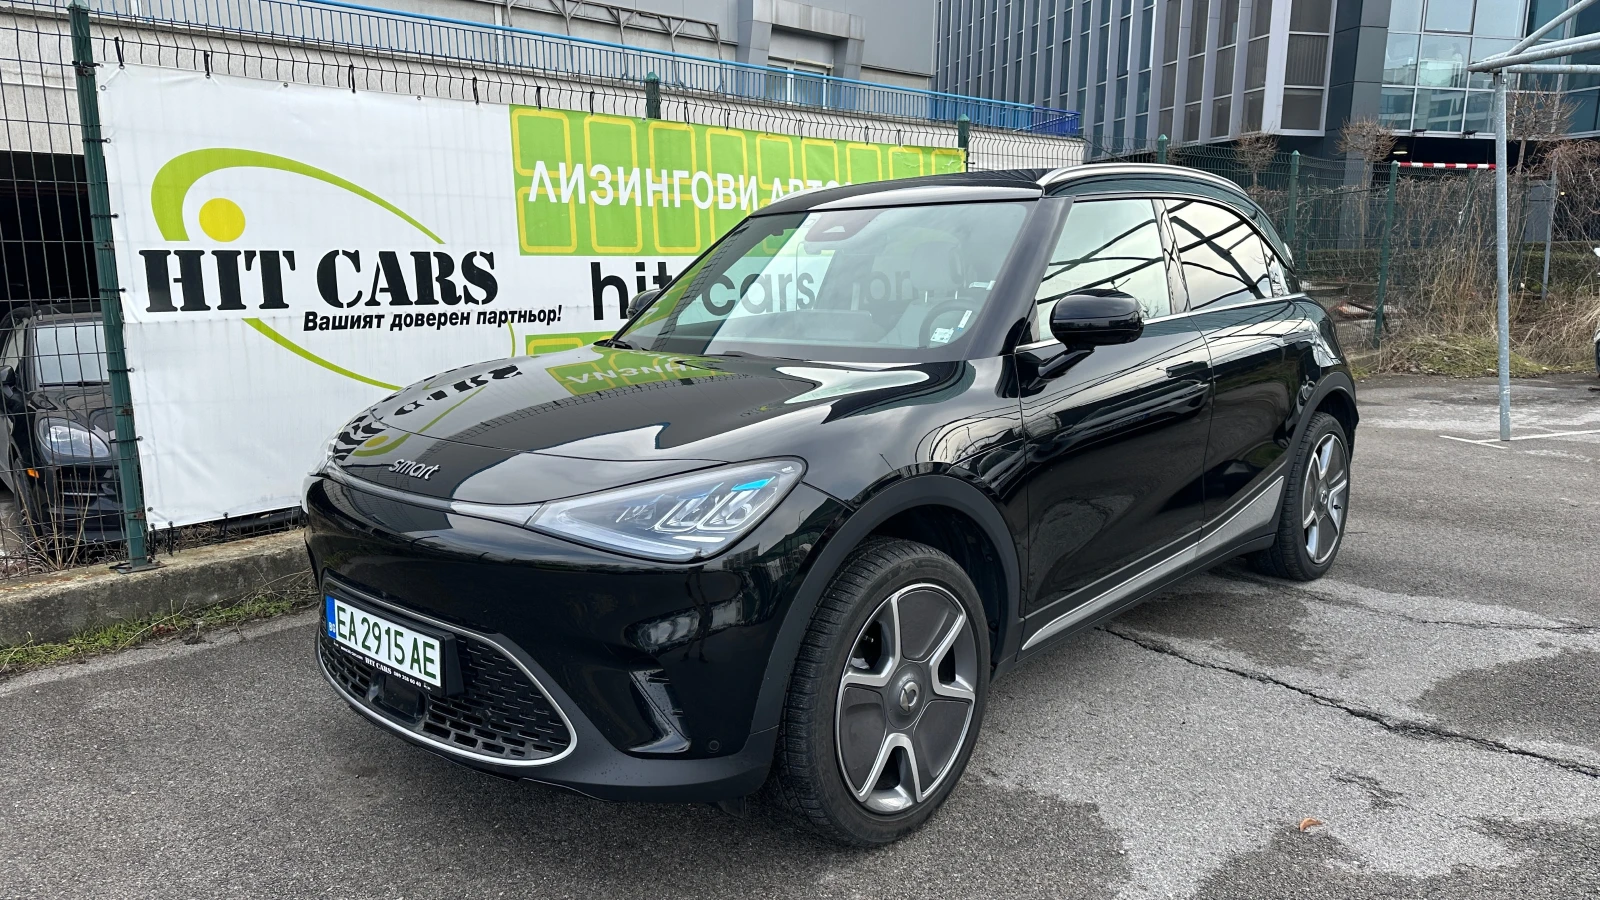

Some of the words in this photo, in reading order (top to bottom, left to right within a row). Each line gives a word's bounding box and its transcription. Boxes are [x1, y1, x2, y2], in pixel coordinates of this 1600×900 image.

[528, 160, 760, 211] ЛИЗИНГОВИ
[138, 249, 296, 312] HIT
[316, 249, 499, 309] CARS
[303, 311, 385, 332] Вашият
[389, 310, 471, 331] доверен
[476, 305, 562, 328] партньор!
[388, 458, 441, 480] smart
[376, 661, 392, 675] CARS
